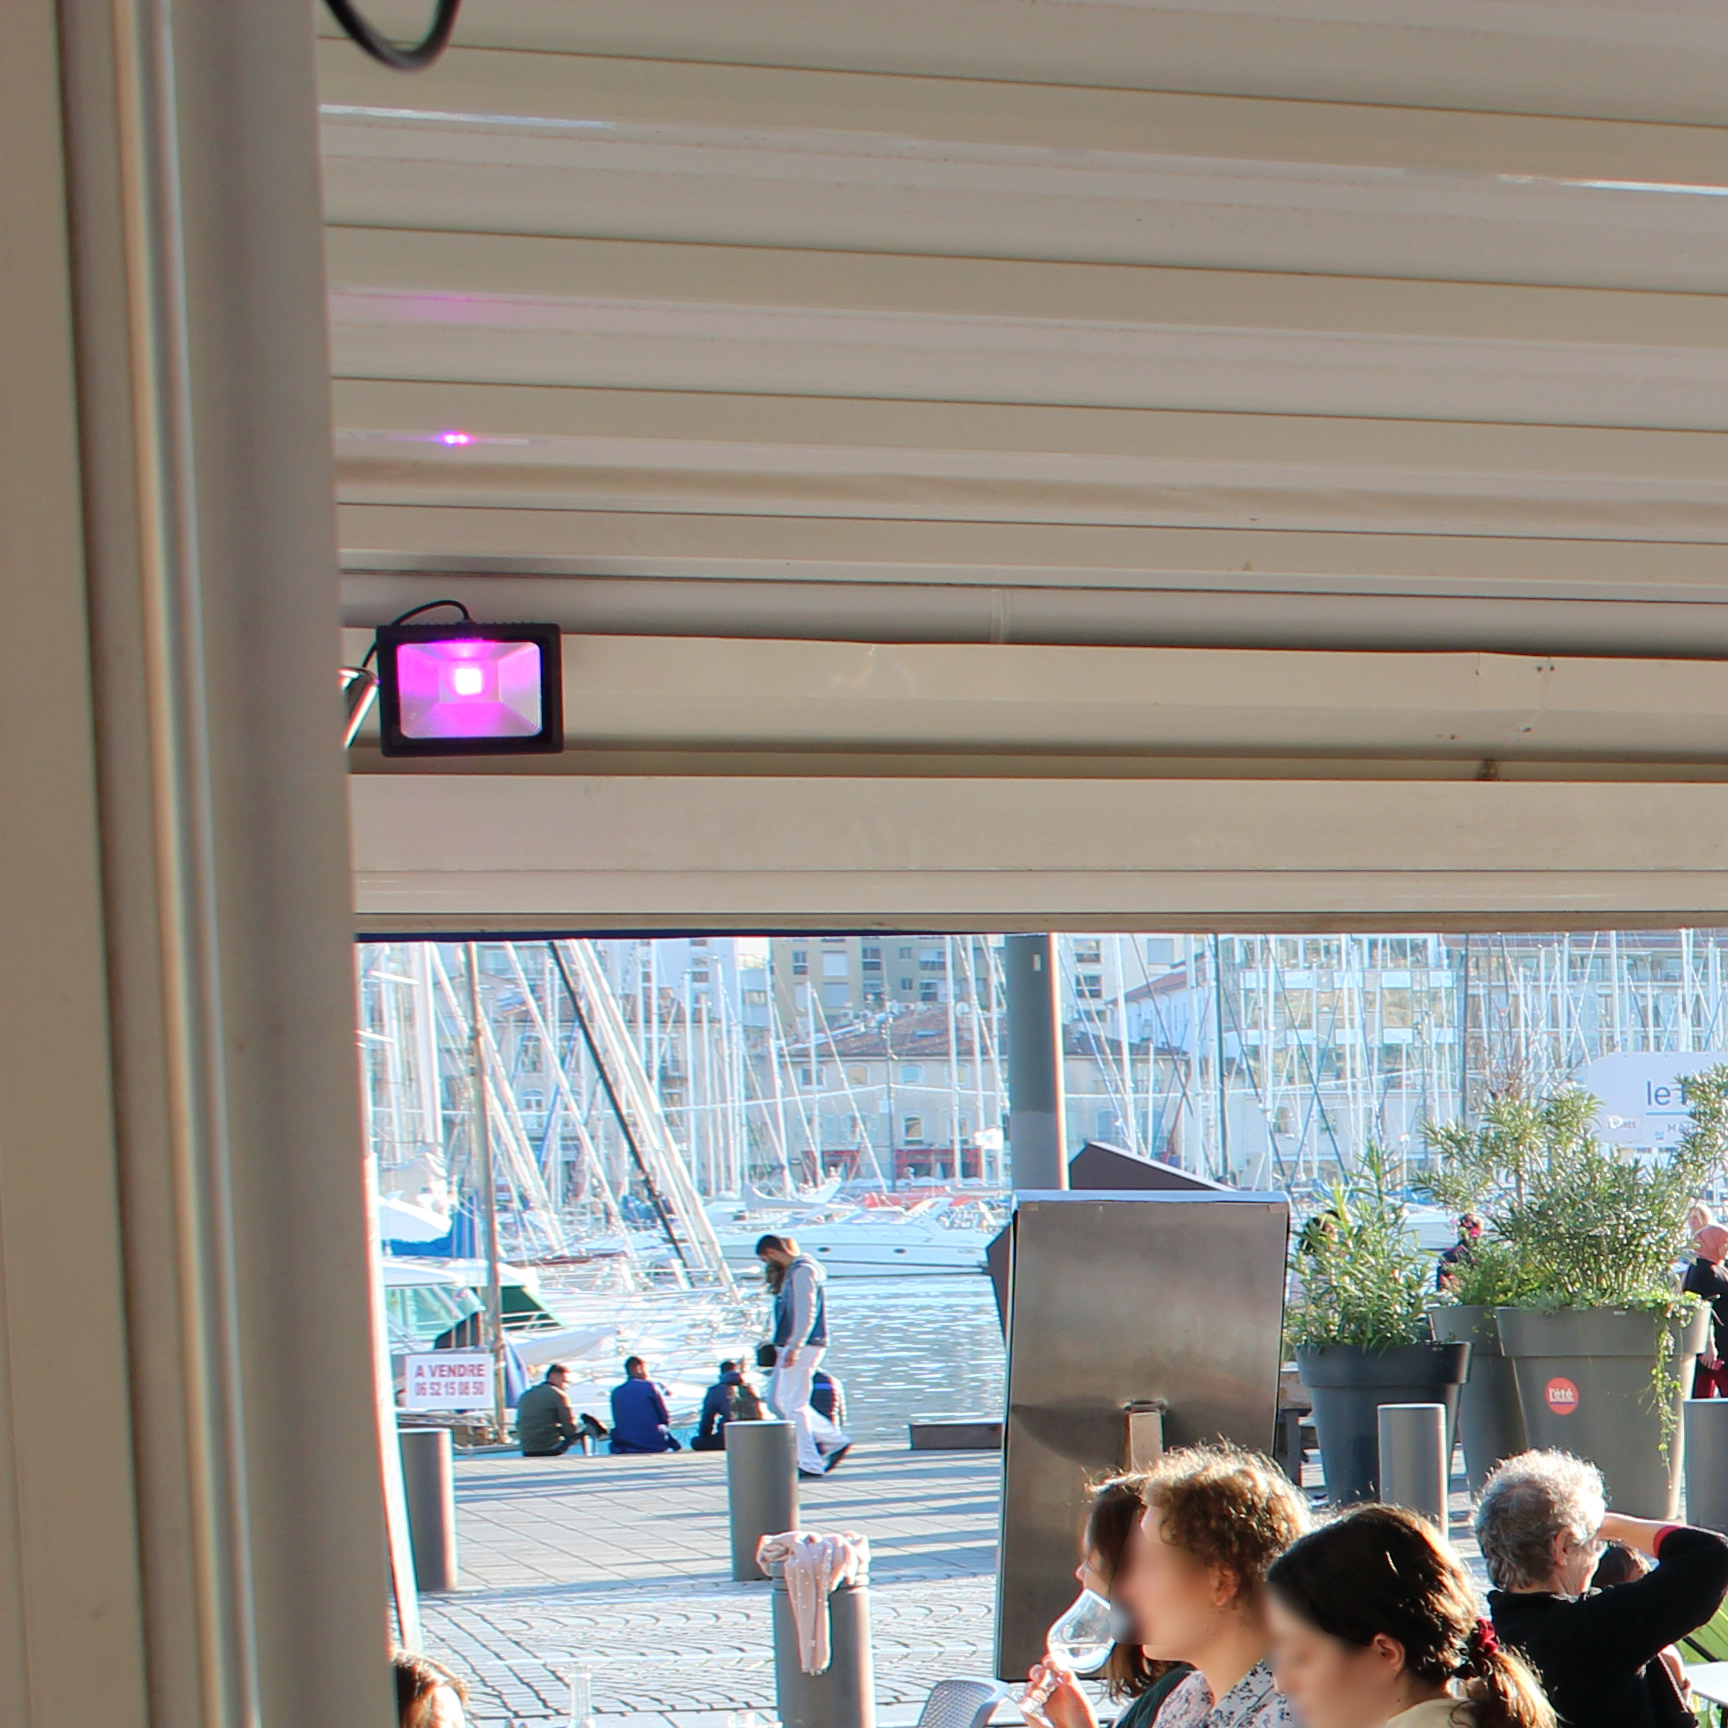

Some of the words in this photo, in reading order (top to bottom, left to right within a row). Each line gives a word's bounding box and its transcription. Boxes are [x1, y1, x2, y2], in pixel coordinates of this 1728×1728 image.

[1646, 1080, 1671, 1106] le
[414, 1364, 426, 1378] A
[428, 1363, 486, 1378] VENDRE
